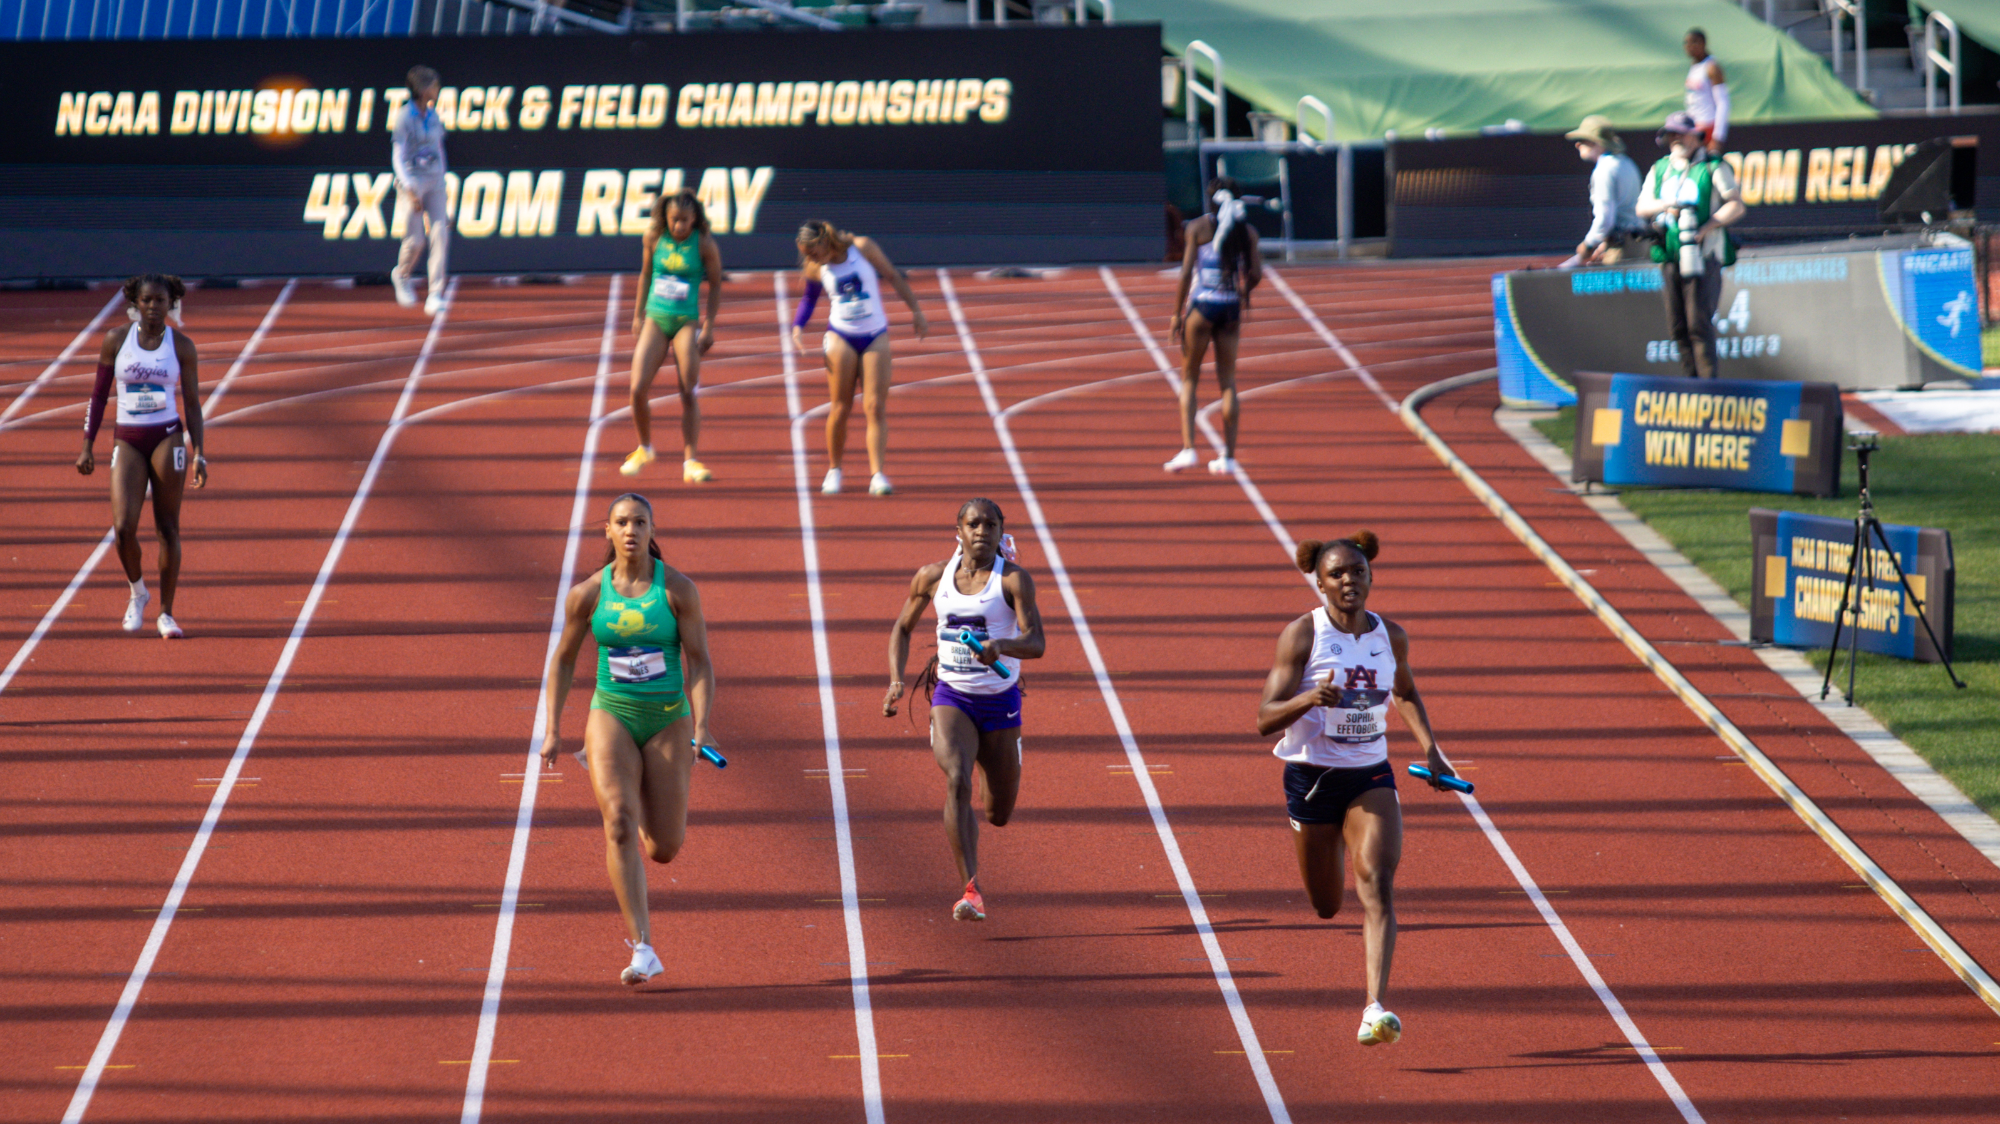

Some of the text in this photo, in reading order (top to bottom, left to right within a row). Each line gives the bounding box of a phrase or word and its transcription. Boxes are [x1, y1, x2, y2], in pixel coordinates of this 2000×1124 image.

[55, 78, 1012, 136] NCAA DIVISION I TACK & FIELD CHAMPIONSHIPS
[124, 361, 169, 379] Aggies
[1634, 391, 1767, 432] CHAMPIONS
[1645, 430, 1750, 471] WIN HERE
[953, 655, 971, 664] ALLEN
[1346, 712, 1374, 724] SOPHIA
